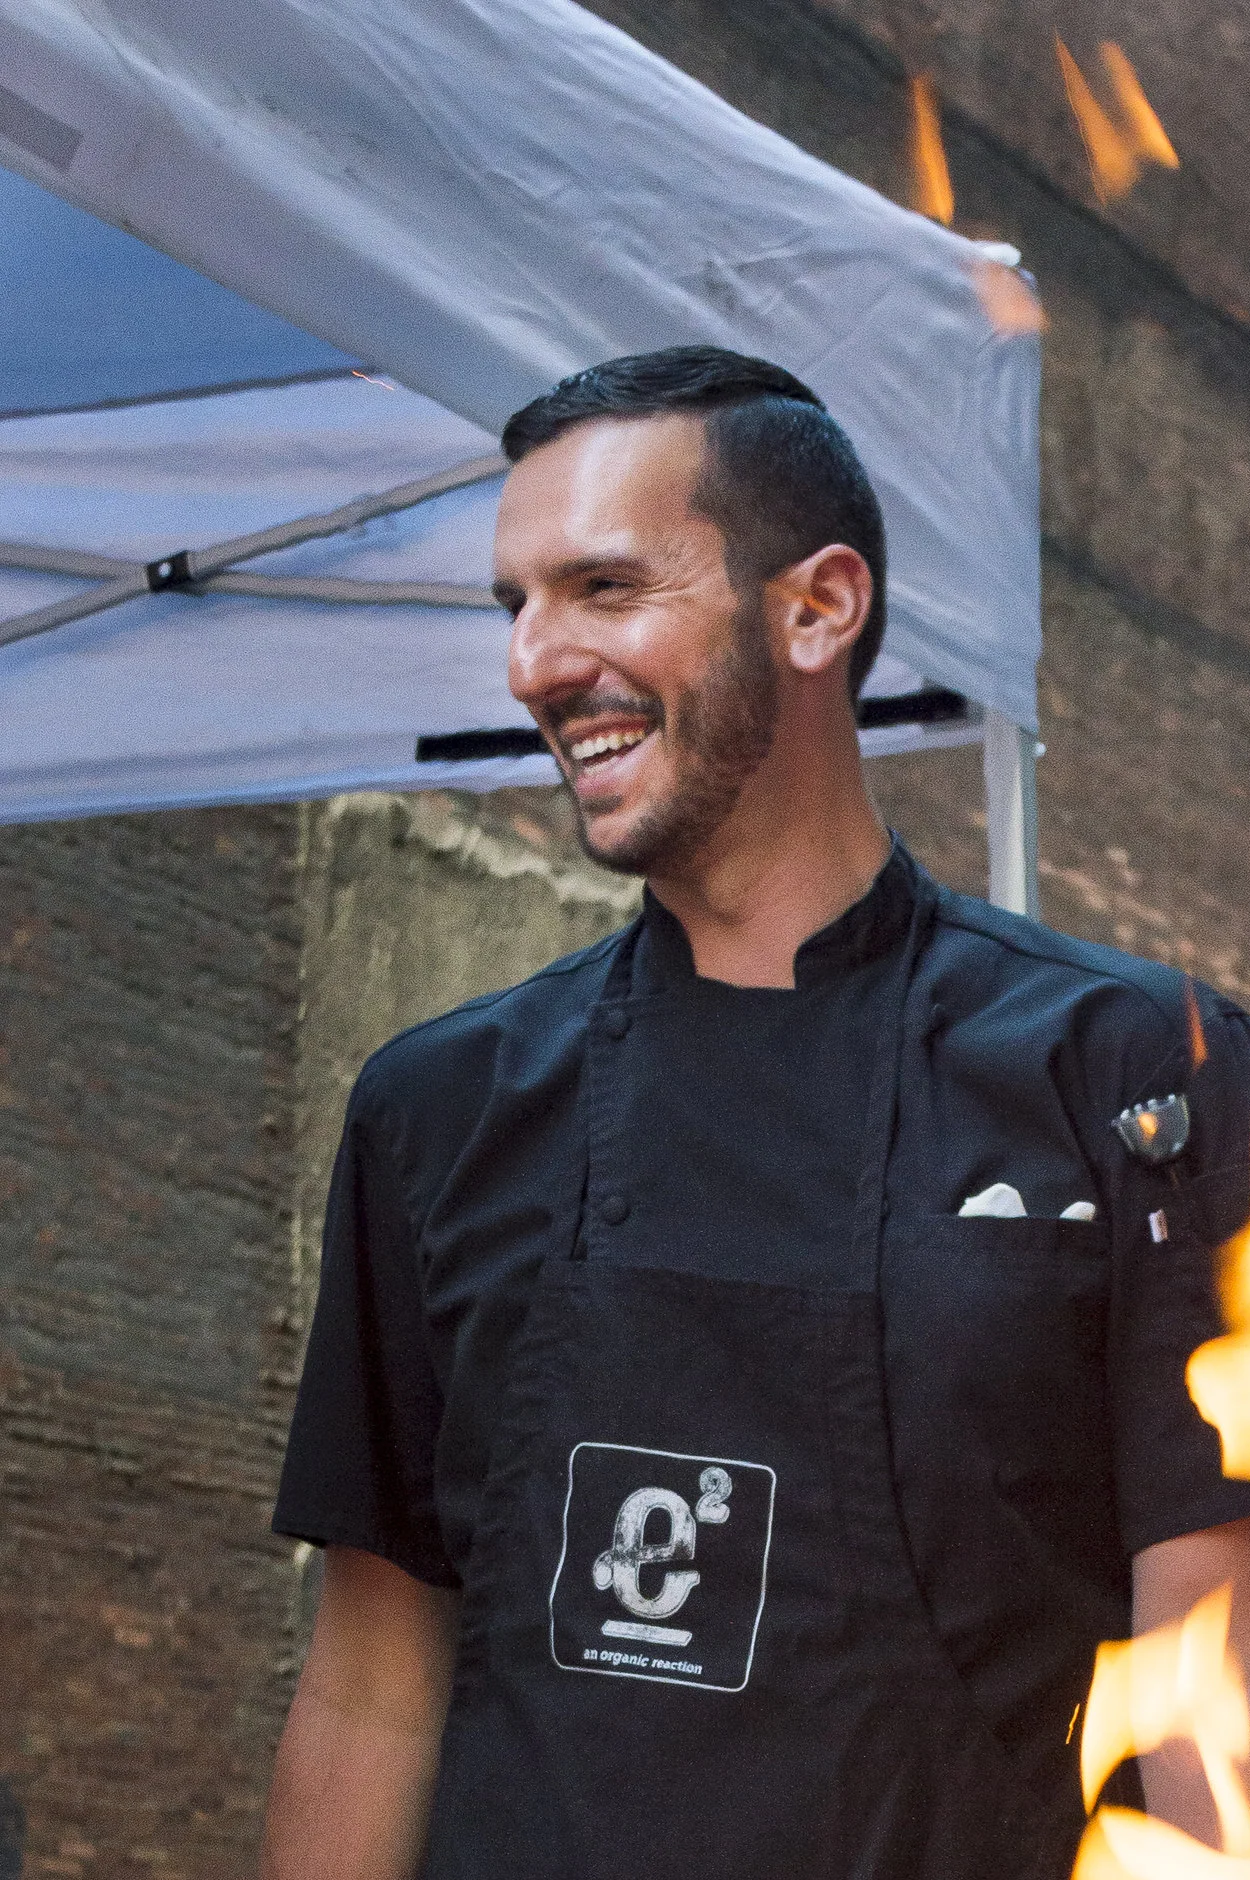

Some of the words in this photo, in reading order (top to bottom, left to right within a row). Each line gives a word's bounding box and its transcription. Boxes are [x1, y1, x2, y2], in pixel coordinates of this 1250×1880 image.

[583, 1648, 598, 1660] an
[600, 1650, 650, 1667] organic
[651, 1659, 703, 1675] reaction
